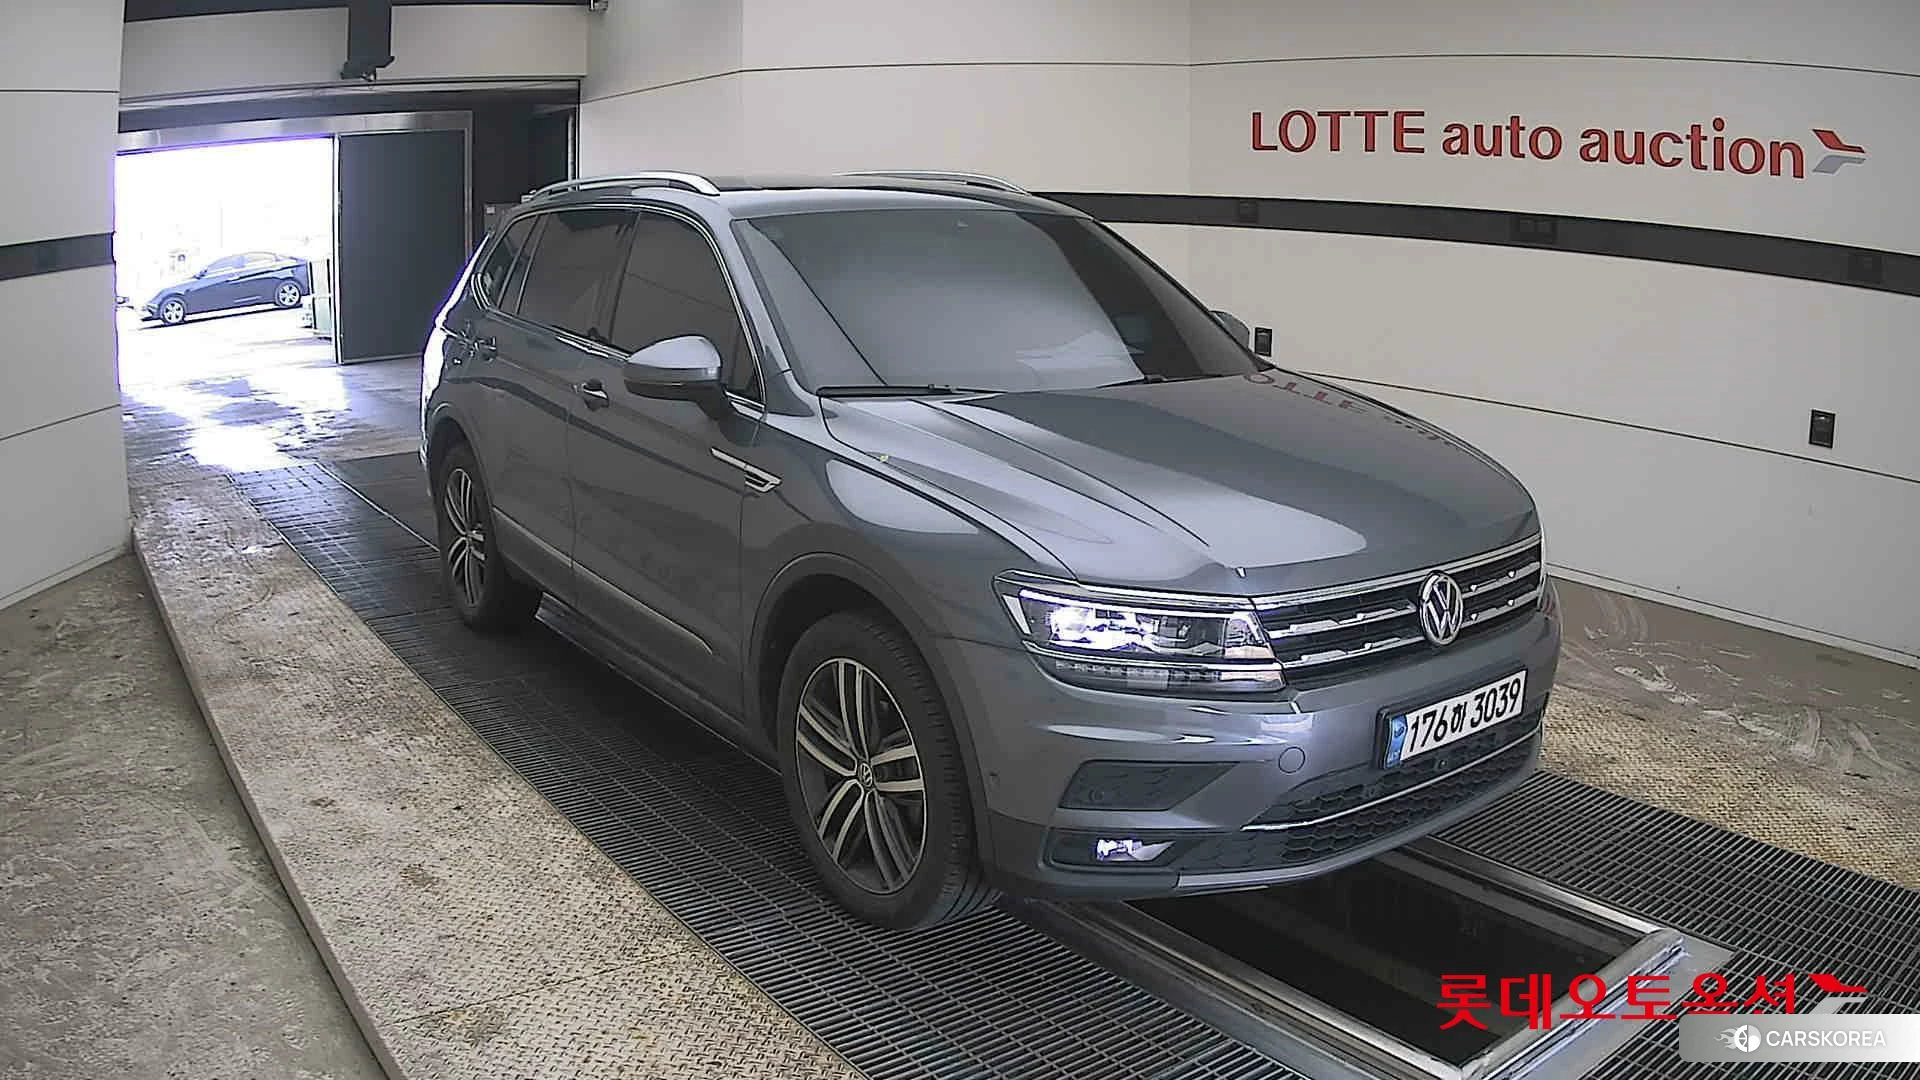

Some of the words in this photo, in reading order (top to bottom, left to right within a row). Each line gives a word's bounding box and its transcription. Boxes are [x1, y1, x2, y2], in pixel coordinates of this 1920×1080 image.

[1251, 110, 1425, 154] LOTTE
[1442, 115, 1562, 160] auto
[1579, 117, 1805, 179] auction
[1470, 677, 1521, 728] 3039
